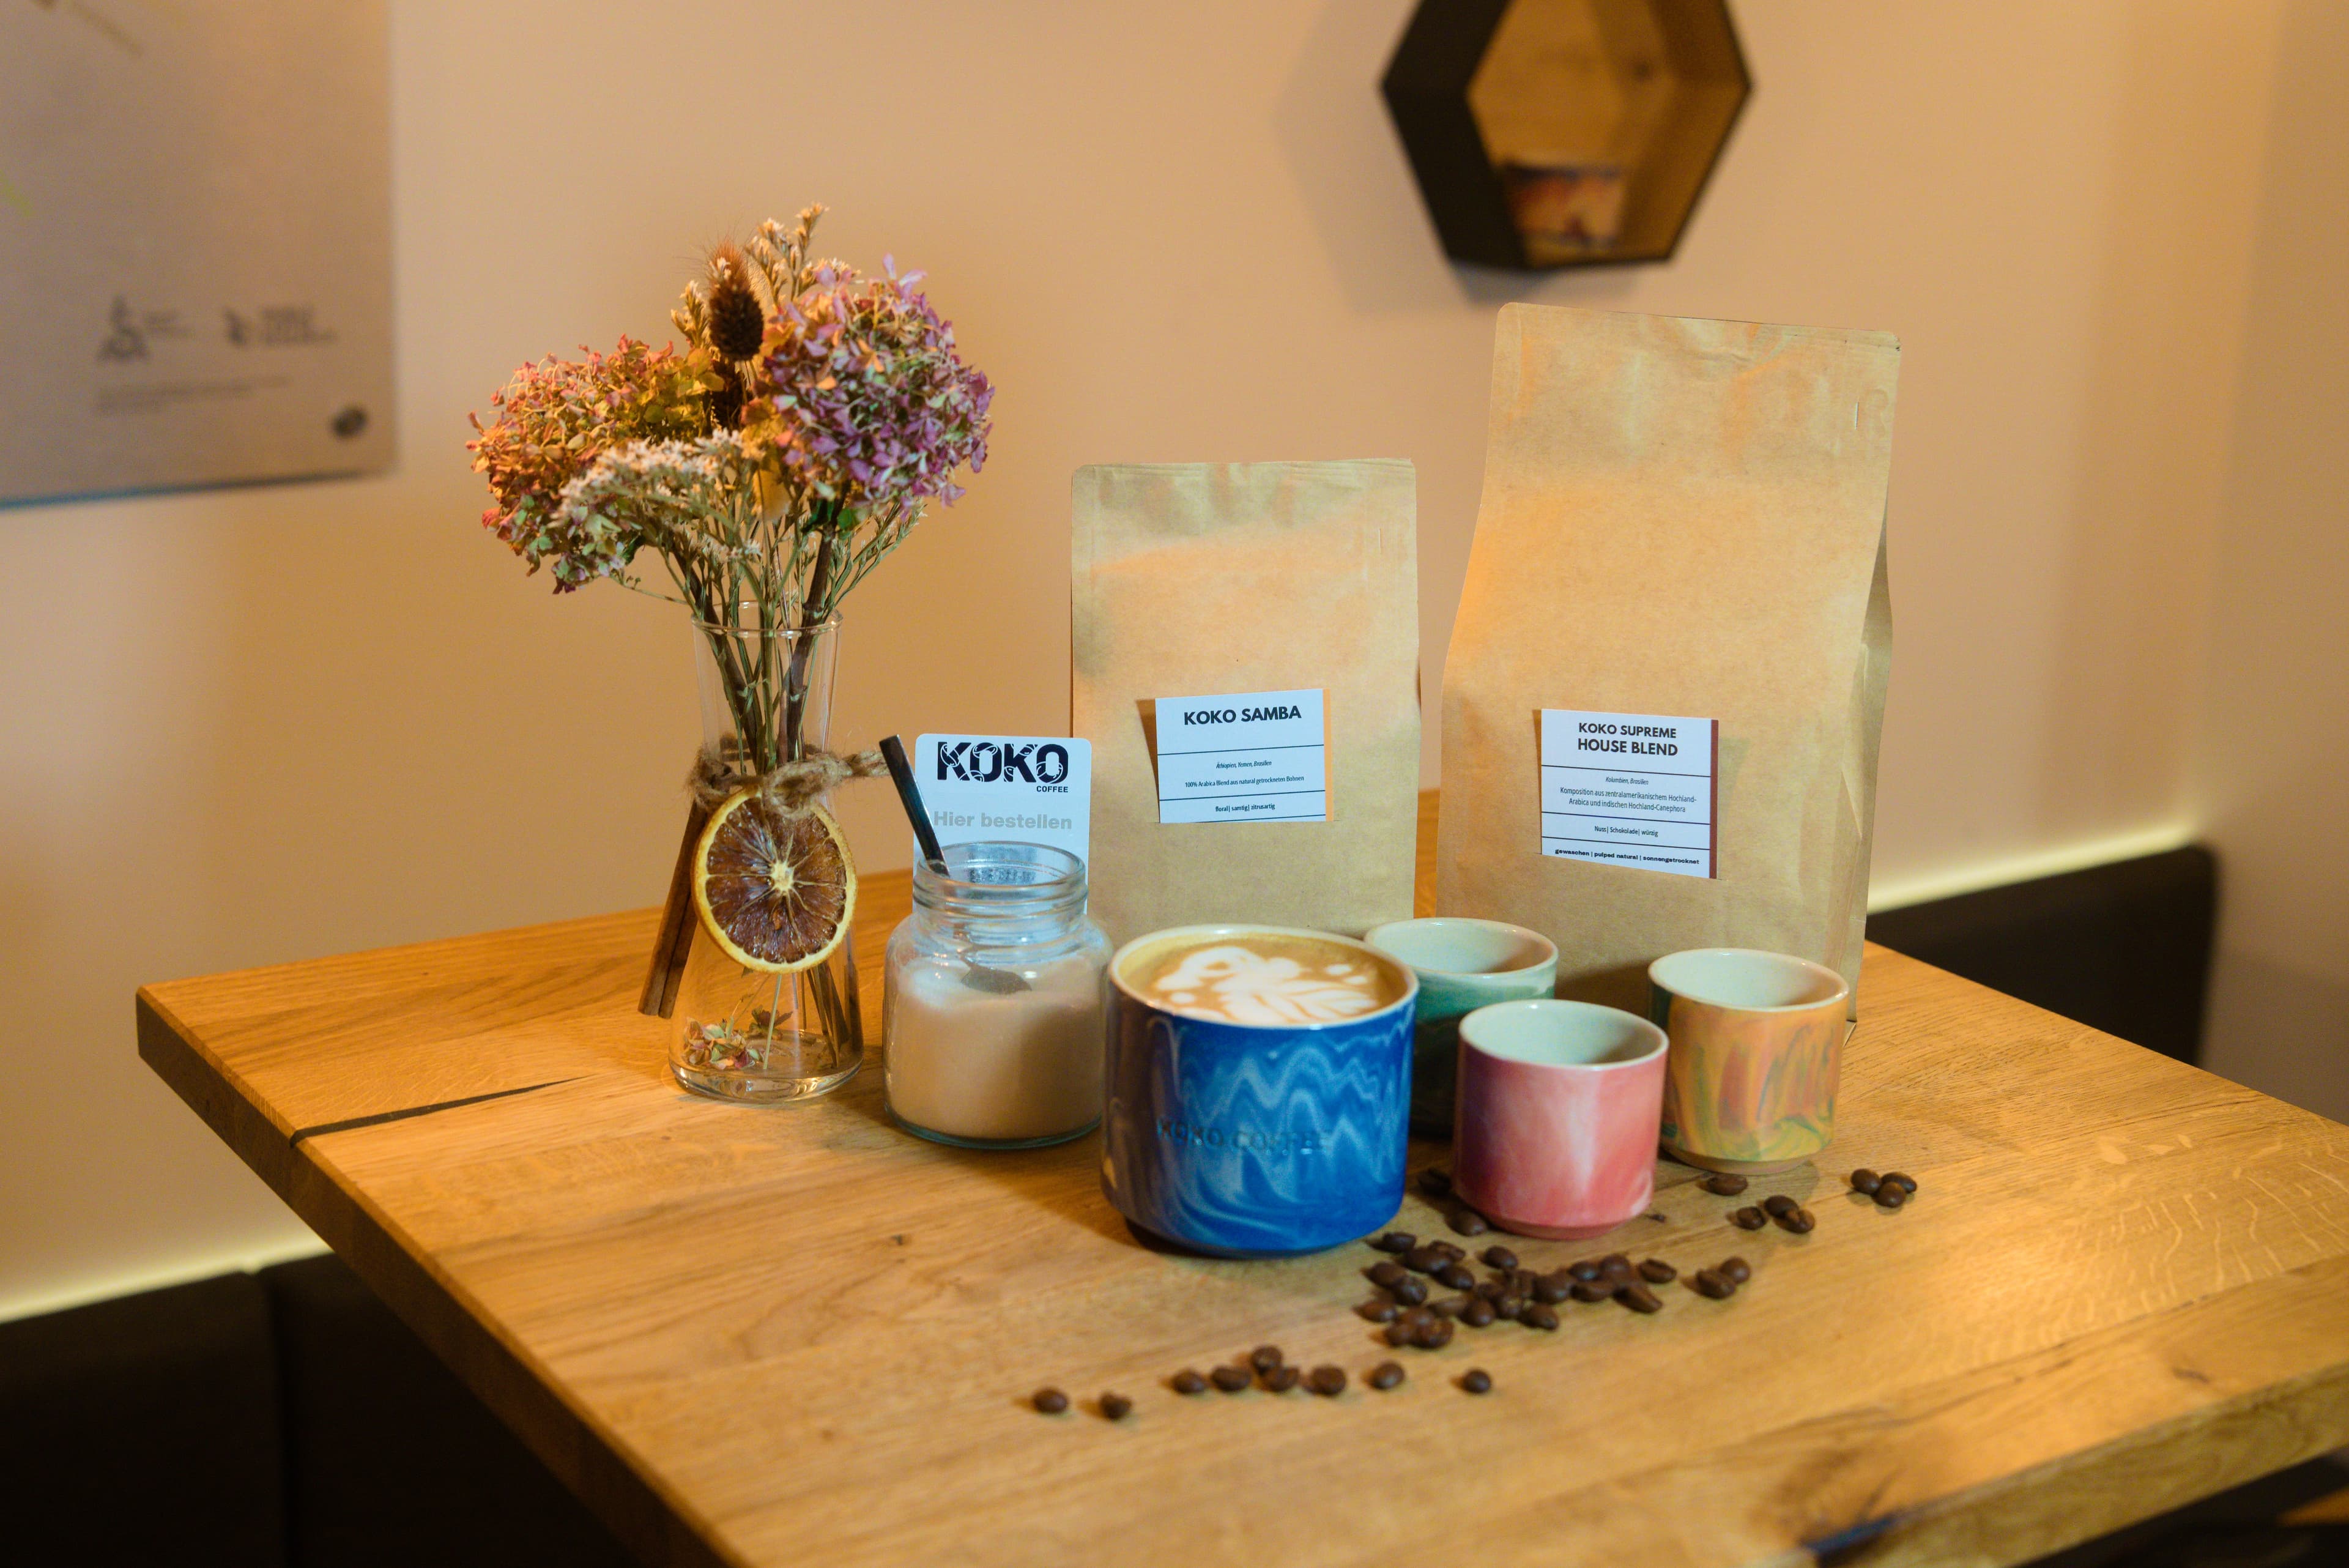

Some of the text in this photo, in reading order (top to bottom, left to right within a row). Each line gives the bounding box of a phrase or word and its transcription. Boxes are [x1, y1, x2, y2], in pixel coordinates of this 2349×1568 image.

[1184, 705, 1302, 725] KOKO SAMBA
[1579, 723, 1677, 738] KOKO SUPREME
[1578, 738, 1678, 756] HOUSE BLEND
[937, 741, 1069, 784] KOKO
[1560, 787, 1594, 796] Komposition
[1605, 791, 1667, 801] zentralamerikanischem
[1628, 803, 1686, 813] Hochland-Canephora
[933, 811, 1072, 830] Hier bestellen
[1643, 855, 1699, 864] sonnengetrocknet
